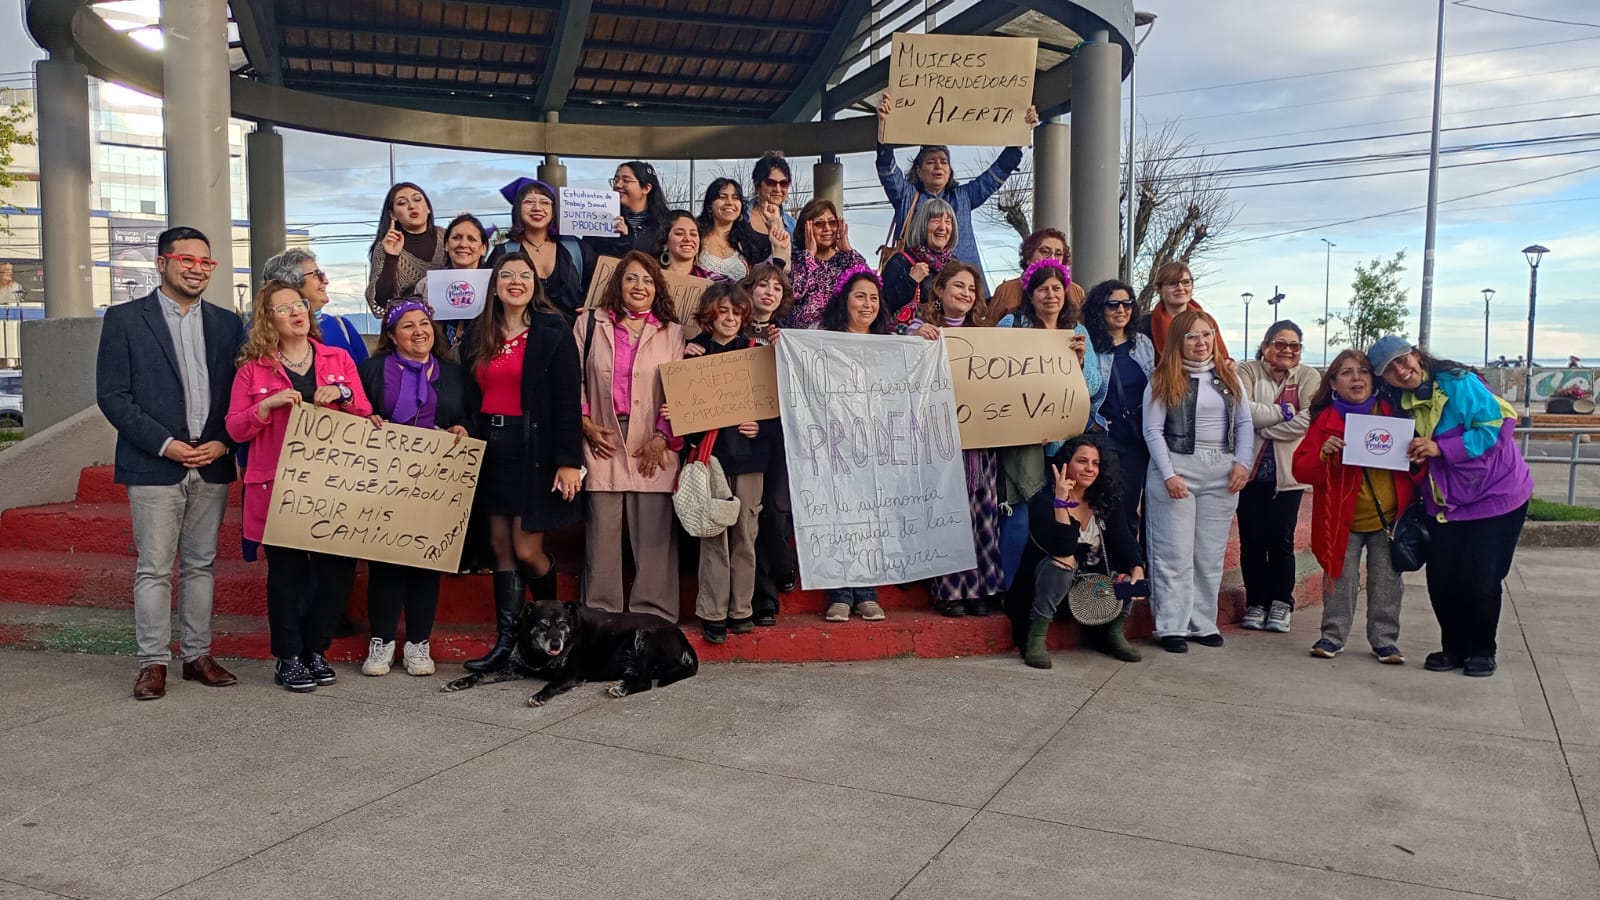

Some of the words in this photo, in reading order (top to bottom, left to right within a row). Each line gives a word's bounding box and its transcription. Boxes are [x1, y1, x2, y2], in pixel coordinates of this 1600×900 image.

[899, 42, 987, 68] MUJERES
[899, 73, 1029, 89] EMPRENDEDORAS
[895, 98, 916, 109] EN
[926, 96, 1014, 125] ALERTA
[563, 189, 603, 199] Estudiantes
[563, 211, 598, 220] JUNTAS
[572, 220, 613, 232] PRODEMU
[786, 349, 831, 408] NO
[836, 360, 866, 398] al
[929, 362, 952, 393] de
[956, 404, 972, 424] O
[984, 402, 1012, 420] SE
[807, 402, 955, 476] PRODEMU
[287, 441, 379, 473] PUERTAS
[387, 457, 401, 474] A
[443, 443, 480, 466] LAS
[281, 467, 310, 484] ME
[325, 475, 445, 502] ENSEÑARON
[448, 492, 463, 508] A
[799, 489, 833, 520] Por
[833, 486, 853, 515] la
[858, 488, 945, 512] autonomía
[829, 517, 896, 558] dignidad
[900, 517, 920, 539] de
[925, 506, 963, 529] las
[857, 547, 949, 579] Mujeres
